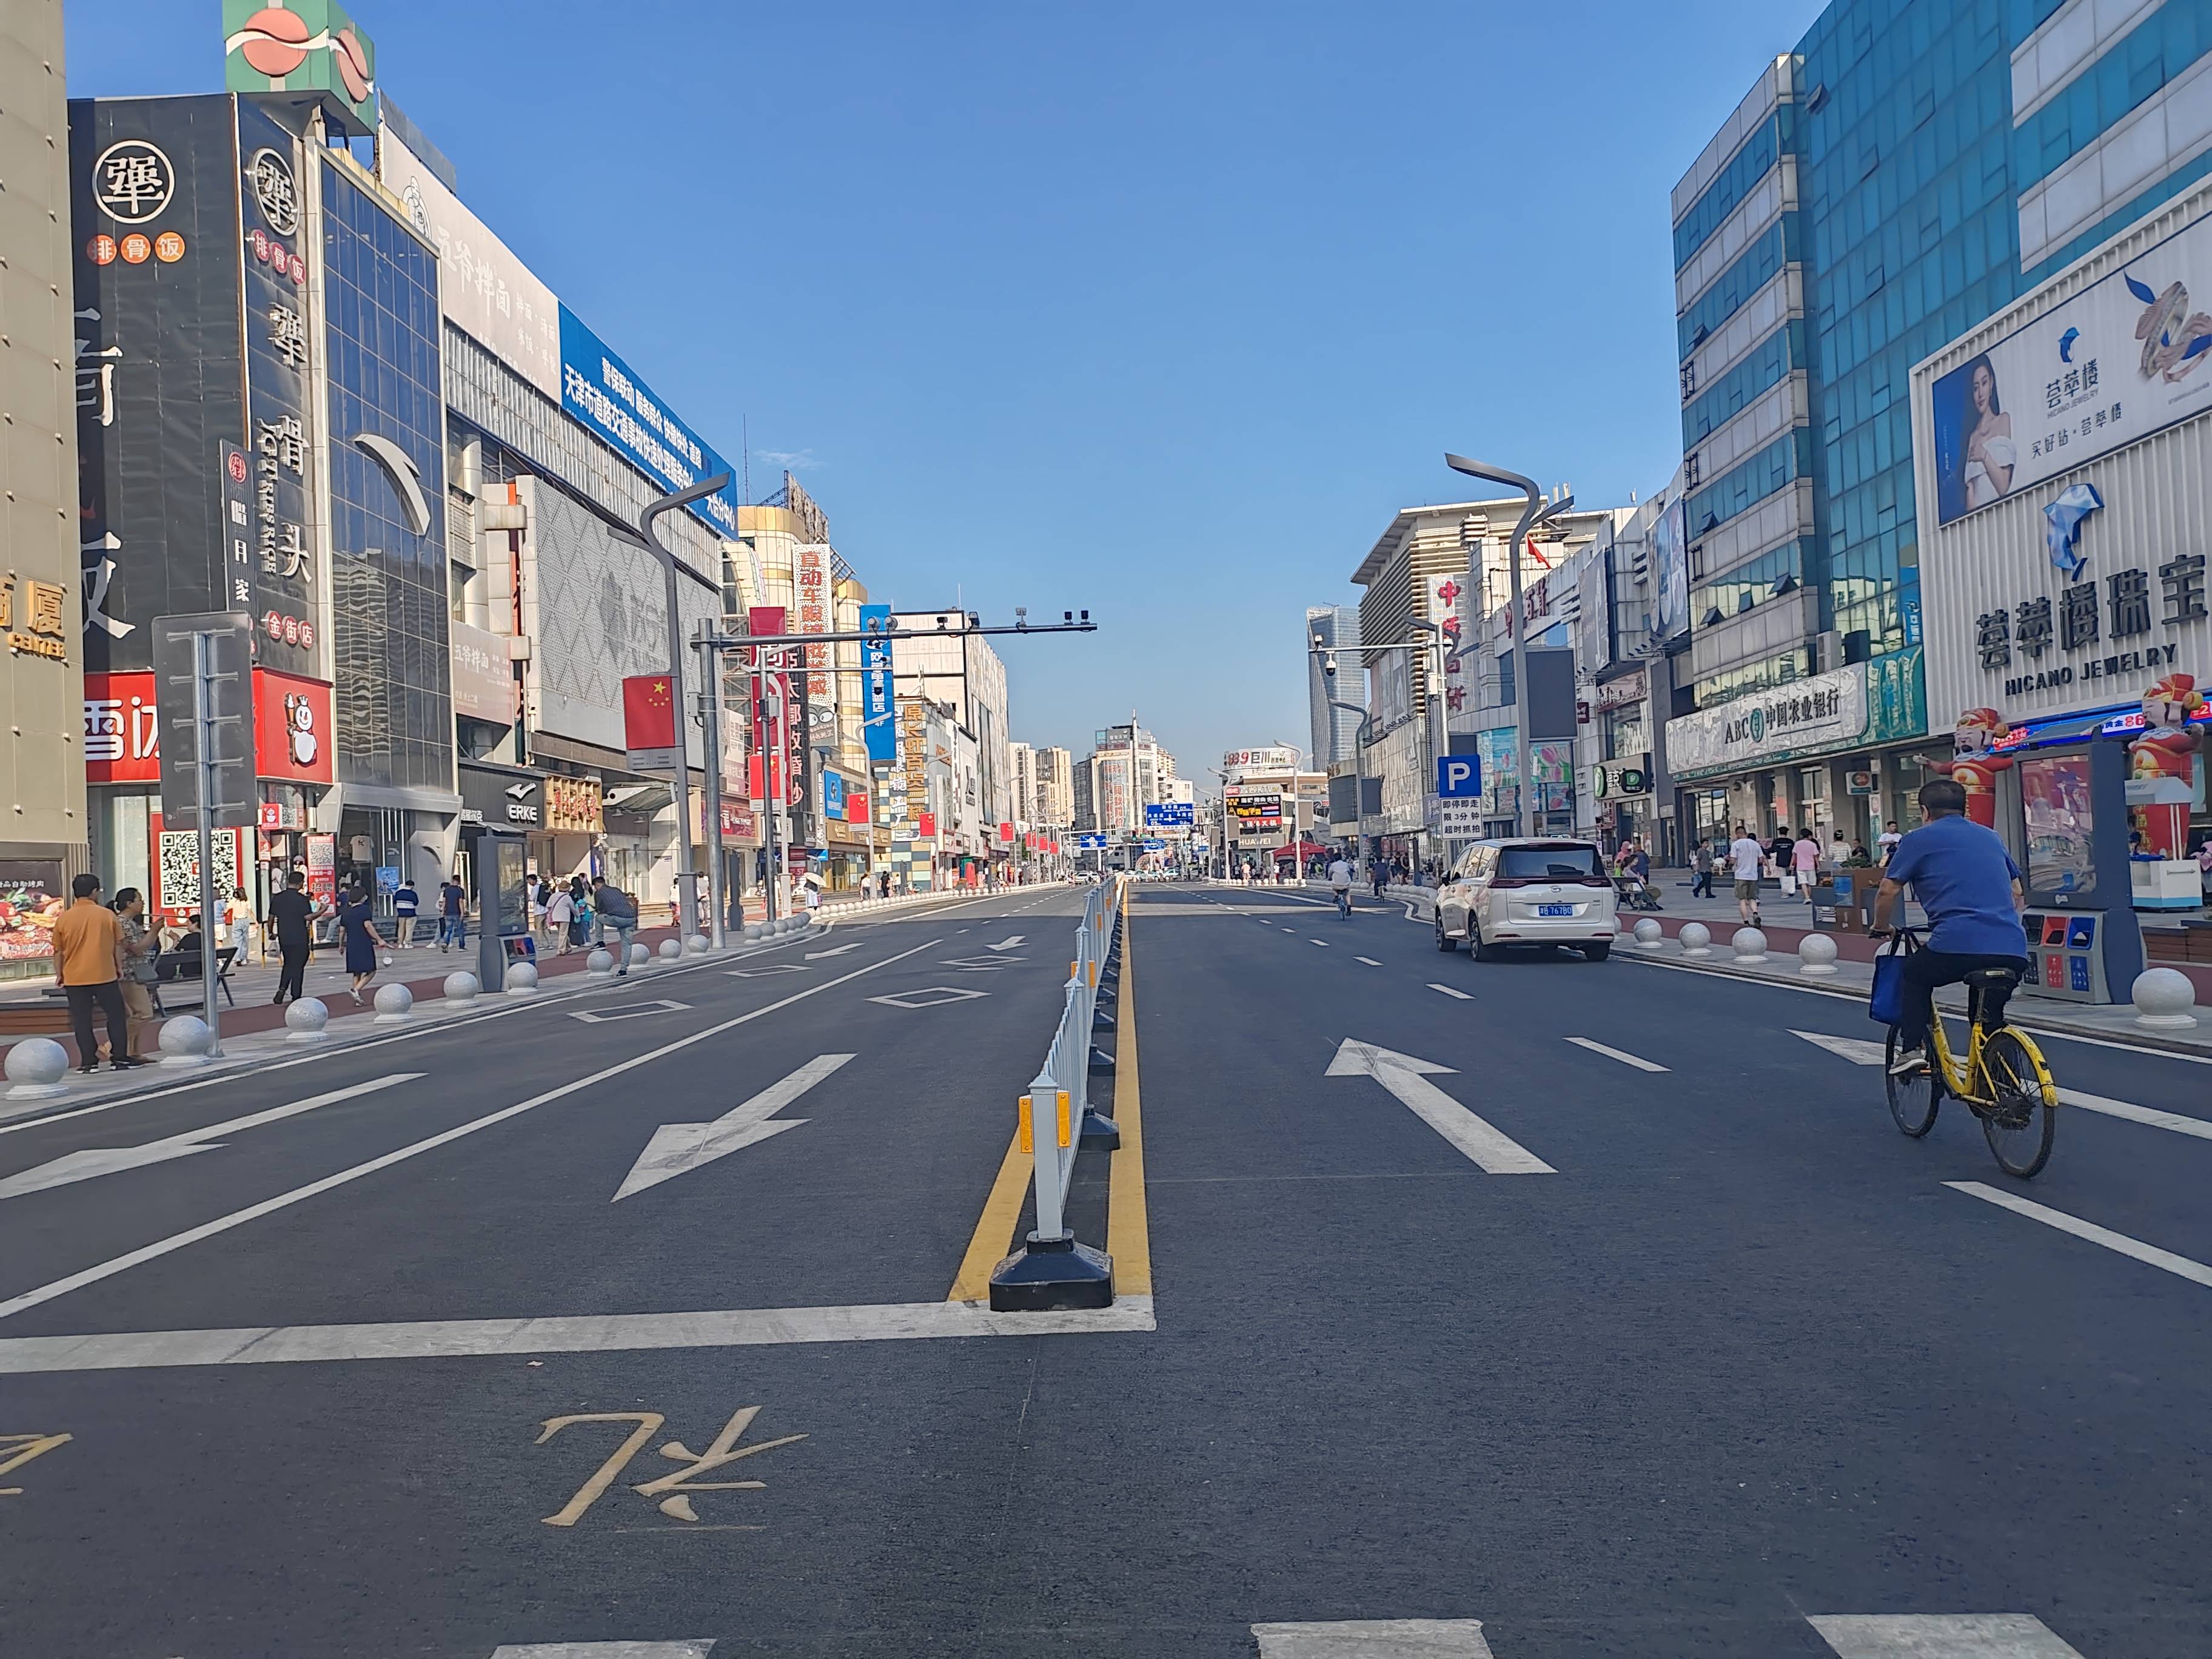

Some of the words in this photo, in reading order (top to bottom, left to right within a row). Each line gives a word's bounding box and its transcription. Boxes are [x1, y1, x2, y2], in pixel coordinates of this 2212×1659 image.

[90, 236, 180, 261] 排骨饭
[253, 230, 306, 282] 排骨饭
[438, 224, 511, 320] 五爷拌面
[602, 357, 635, 407] 警保联动
[635, 388, 663, 435] 服务群众
[2046, 358, 2099, 409] 荟萃楼
[2047, 403, 2070, 420] HICANO
[2070, 388, 2099, 409] JEWELRY
[1504, 577, 1547, 639] 中百货
[1976, 554, 2208, 669] 荟萃楼珠宝
[8, 632, 66, 658] CENTER
[268, 616, 313, 646] 金街店
[454, 644, 489, 673] 五爷拌面
[2005, 666, 2073, 697] HICANO
[2080, 643, 2177, 681] JEWELRY
[1766, 688, 1839, 730] 中国农业银行
[1724, 717, 1749, 744] ABC
[903, 705, 926, 821] 原长虹百货三楼
[1448, 762, 1470, 791] P
[507, 803, 538, 822] ERKE
[1443, 799, 1479, 809] 即停即走
[1444, 825, 1480, 834] 超时抓拍
[312, 882, 333, 893] 招聘
